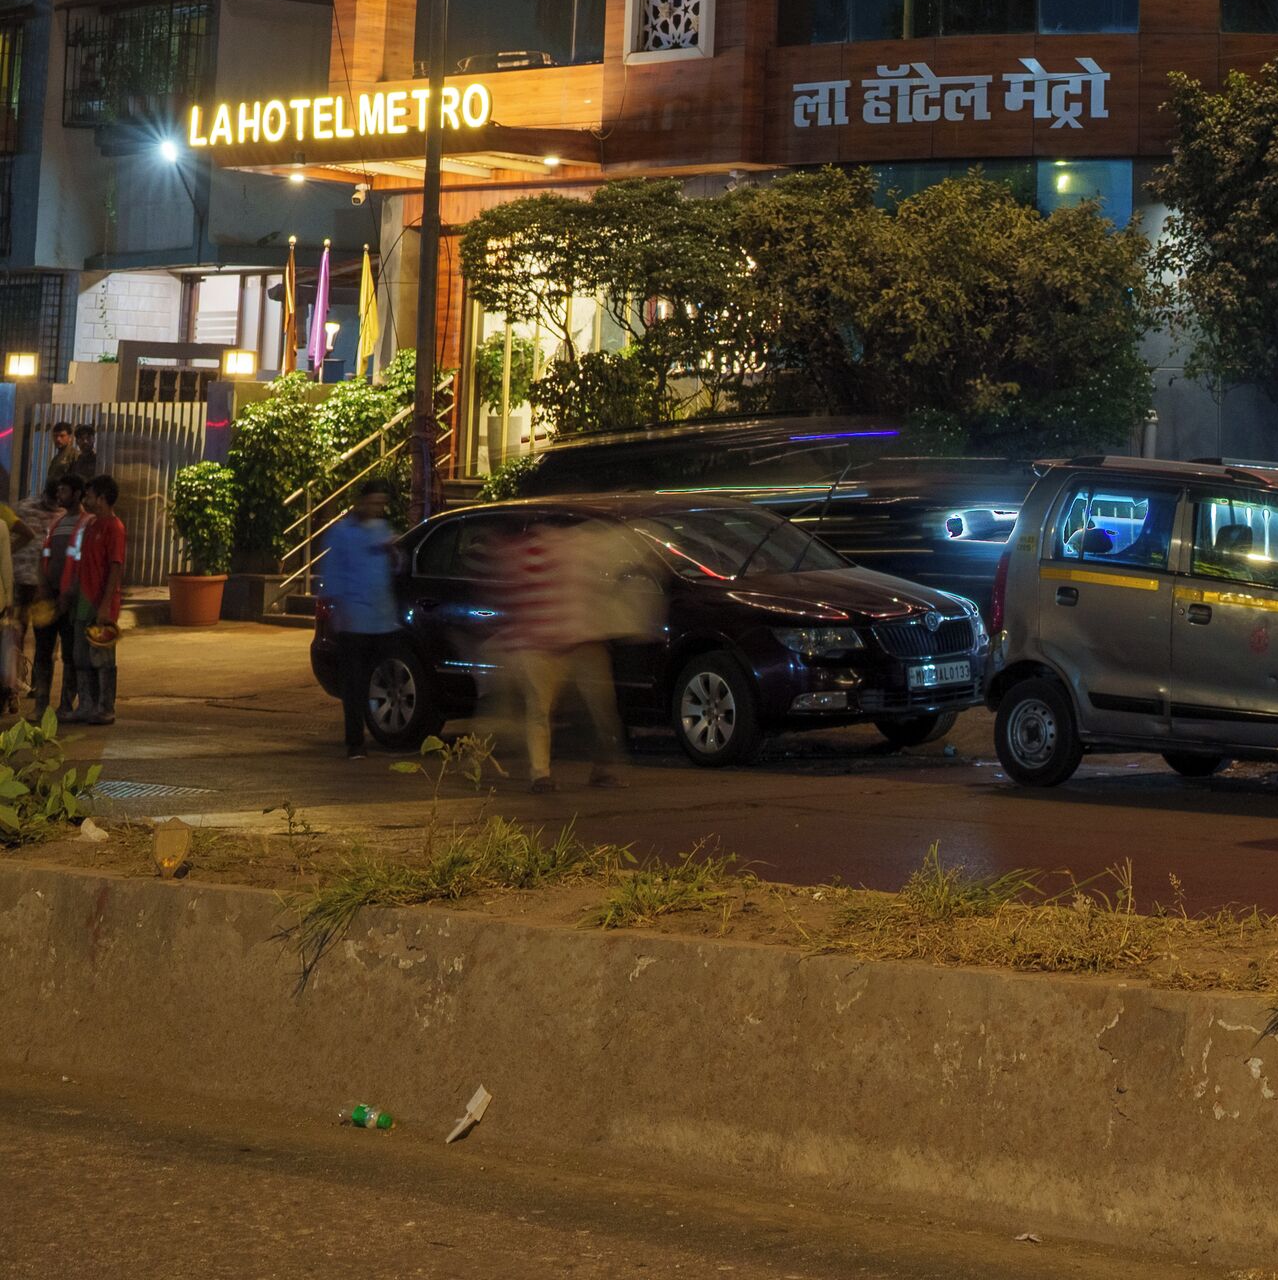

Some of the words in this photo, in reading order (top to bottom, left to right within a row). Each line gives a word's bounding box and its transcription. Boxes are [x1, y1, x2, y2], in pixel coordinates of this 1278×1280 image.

[793, 80, 851, 128] ला
[861, 62, 993, 124] हॉटेल
[1002, 57, 1111, 129] मेट्रो
[915, 664, 970, 684] MAL0133
